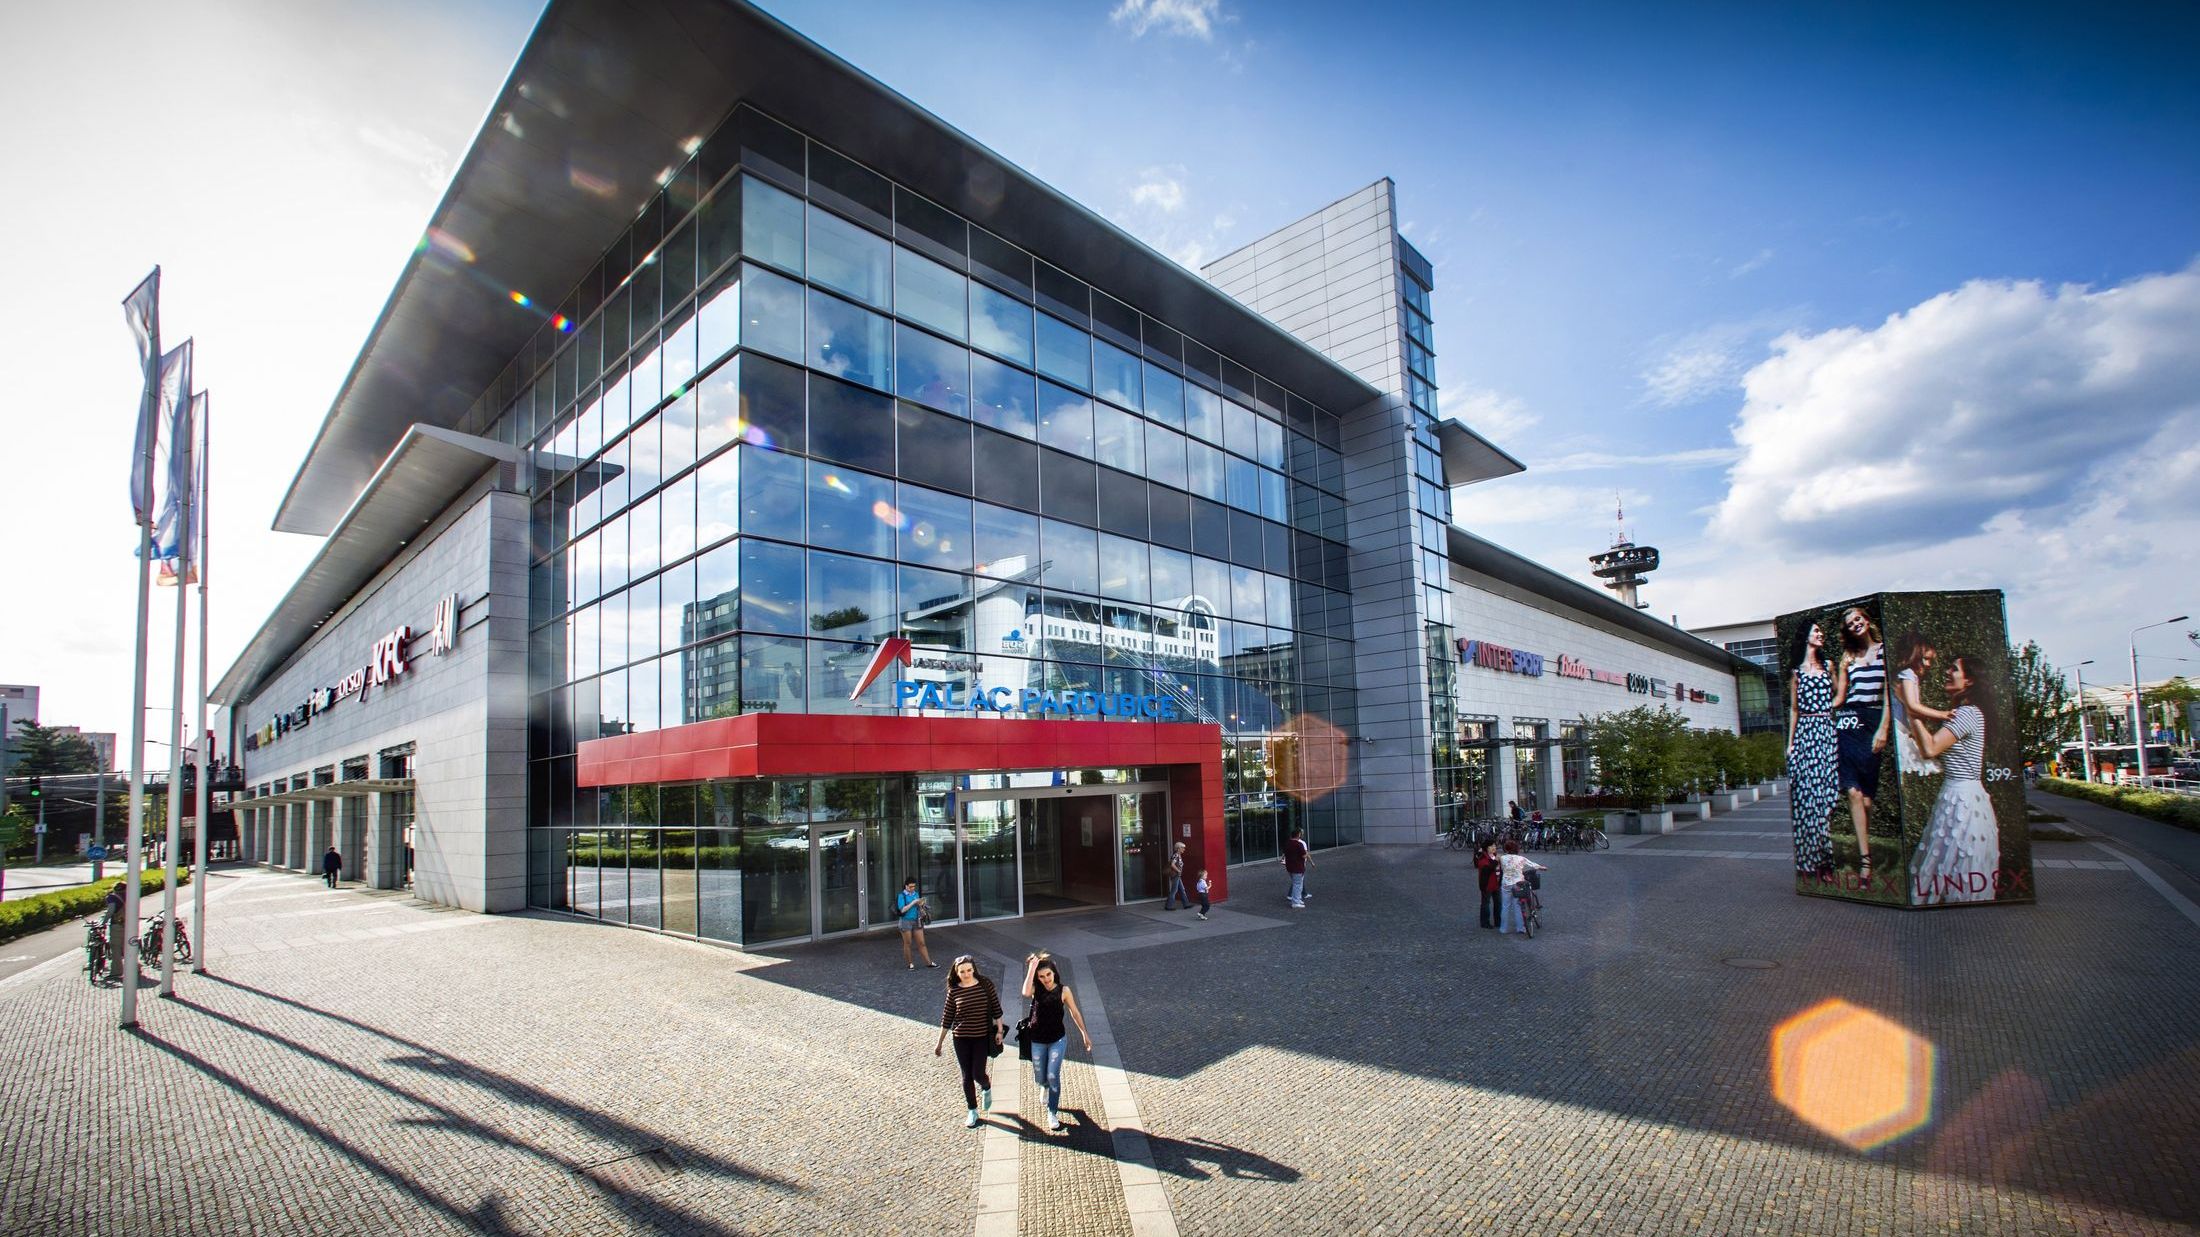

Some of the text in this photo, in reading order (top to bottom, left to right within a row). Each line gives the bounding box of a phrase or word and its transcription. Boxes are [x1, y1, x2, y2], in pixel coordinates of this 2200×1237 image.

[371, 625, 410, 687] KFC
[1475, 640, 1544, 677] INTERSPORT
[338, 666, 367, 702] orsay
[896, 679, 1176, 718] PALÁC PARDUBICE
[1801, 869, 1900, 897] LINDEX
[1913, 867, 2029, 898] LINDEX
